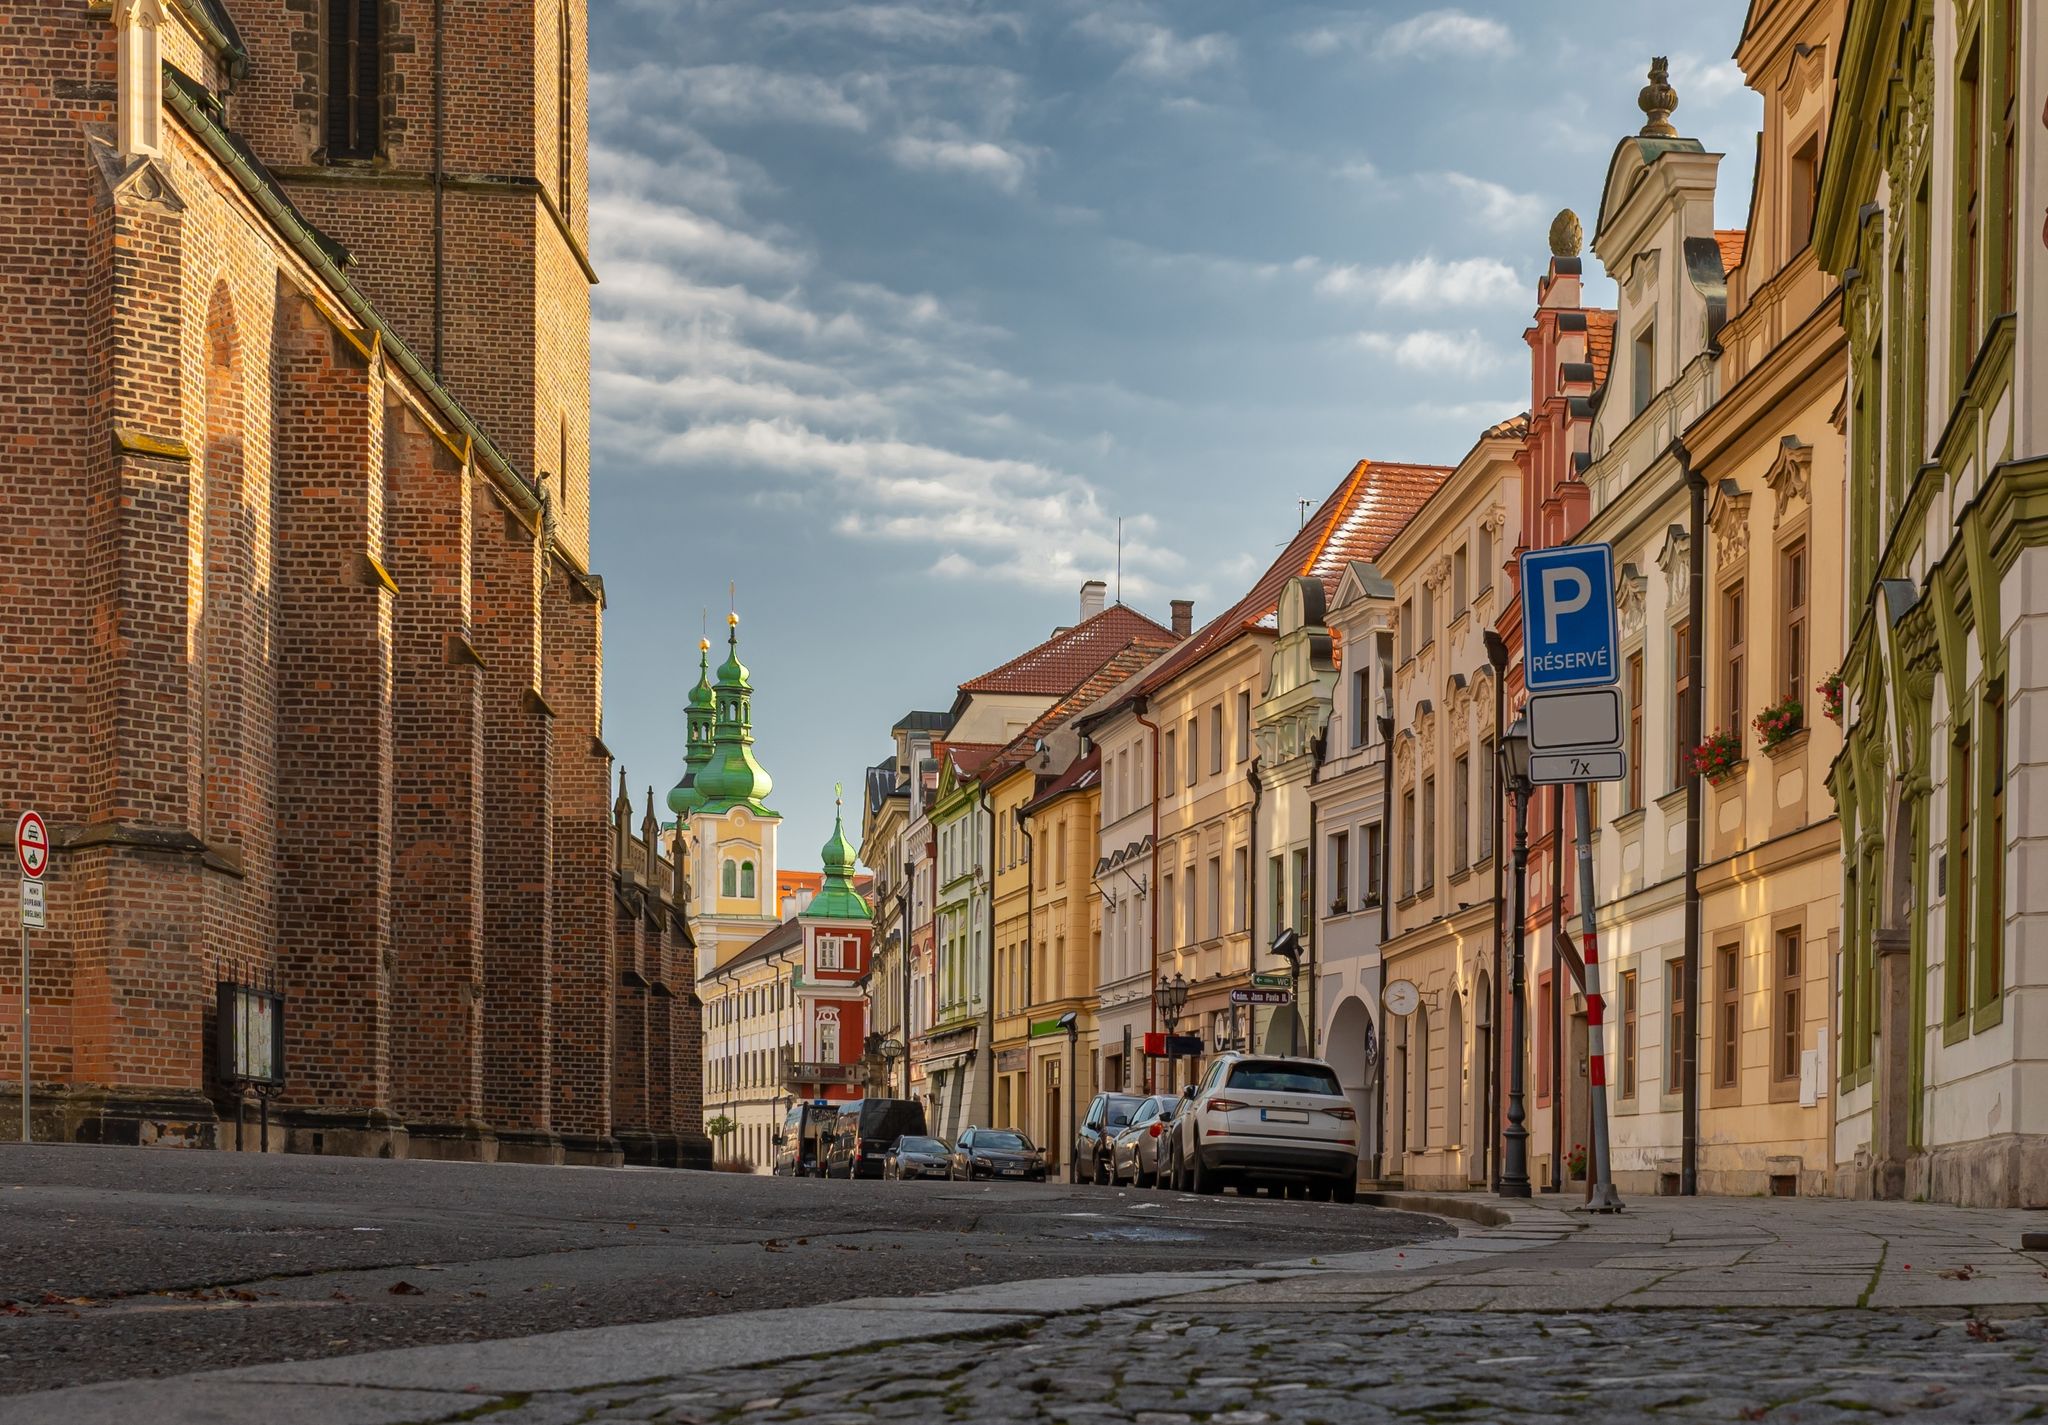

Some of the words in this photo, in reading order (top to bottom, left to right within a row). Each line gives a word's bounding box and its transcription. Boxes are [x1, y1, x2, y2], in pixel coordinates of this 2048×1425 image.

[1542, 566, 1592, 644] P
[1533, 647, 1607, 672] RÉSERVÉ
[1570, 758, 1590, 775] 7x
[1278, 978, 1288, 986] WC
